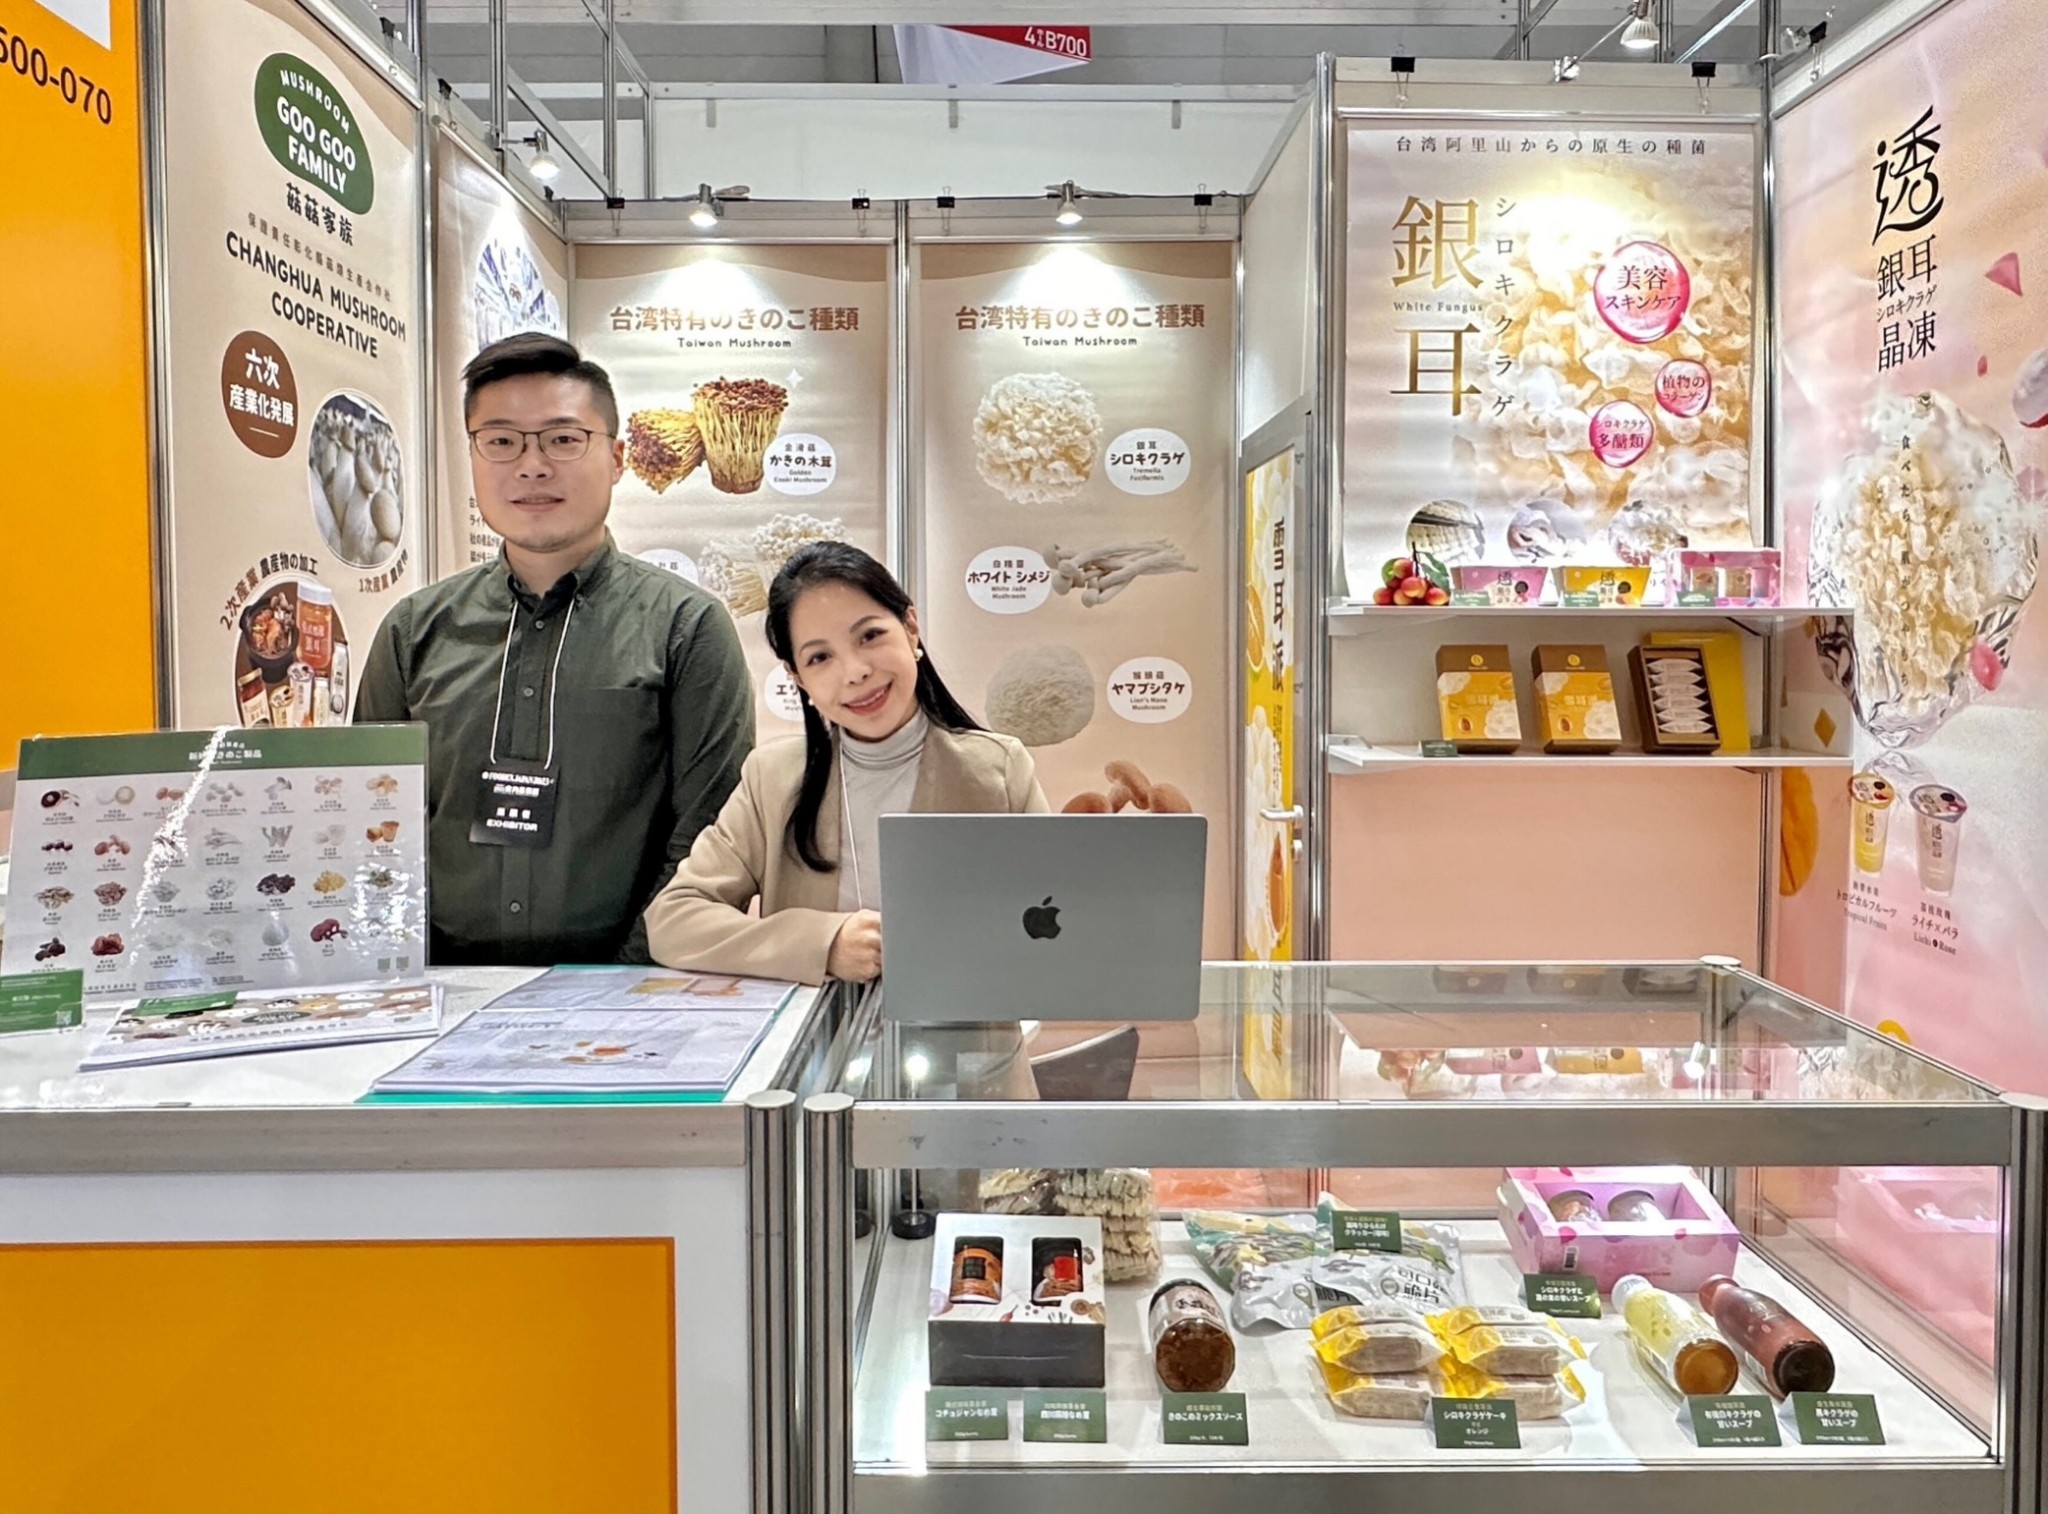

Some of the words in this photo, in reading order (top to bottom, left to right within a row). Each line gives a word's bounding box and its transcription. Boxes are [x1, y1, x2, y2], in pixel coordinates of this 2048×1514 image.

[279, 69, 350, 133] MUSHROOM
[276, 96, 316, 142] GOO
[319, 127, 357, 171] GOO
[1396, 136, 1706, 155] 台湾阿里山からの原生の種菌
[288, 140, 347, 194] FAMILY
[1872, 104, 1945, 246] 透
[1616, 265, 1668, 291] 美容
[1877, 234, 1937, 300] 銀耳
[226, 230, 324, 302] CHANGHUA
[330, 286, 406, 340] MUSHROOM
[1393, 302, 1432, 311] White
[1437, 302, 1483, 314] Fungus
[1491, 197, 1517, 418] シロキクラゲ
[1605, 296, 1682, 311] スキンケア
[1876, 284, 1938, 323] シロキクラゲ
[271, 291, 378, 359] COOPERATIVE
[610, 306, 859, 332] 台湾特有のきのこ種類
[955, 304, 1205, 330] 台湾特有のきのこ種類
[677, 337, 722, 348] Taiwan
[729, 337, 792, 348] Mushroom
[1023, 336, 1068, 347] Taiwan
[1074, 336, 1137, 347] Mushroom
[1878, 310, 1937, 373] 晶凍
[245, 348, 280, 390] 六次
[1662, 375, 1705, 388] 植物の
[229, 384, 294, 427] 産業化発展
[770, 455, 832, 467] かきの木茸
[1110, 452, 1185, 465] シロキクラゲ
[968, 571, 1011, 583] ホワイト
[1016, 571, 1051, 583] シメジ
[1112, 682, 1185, 695] ヤマブシタケ
